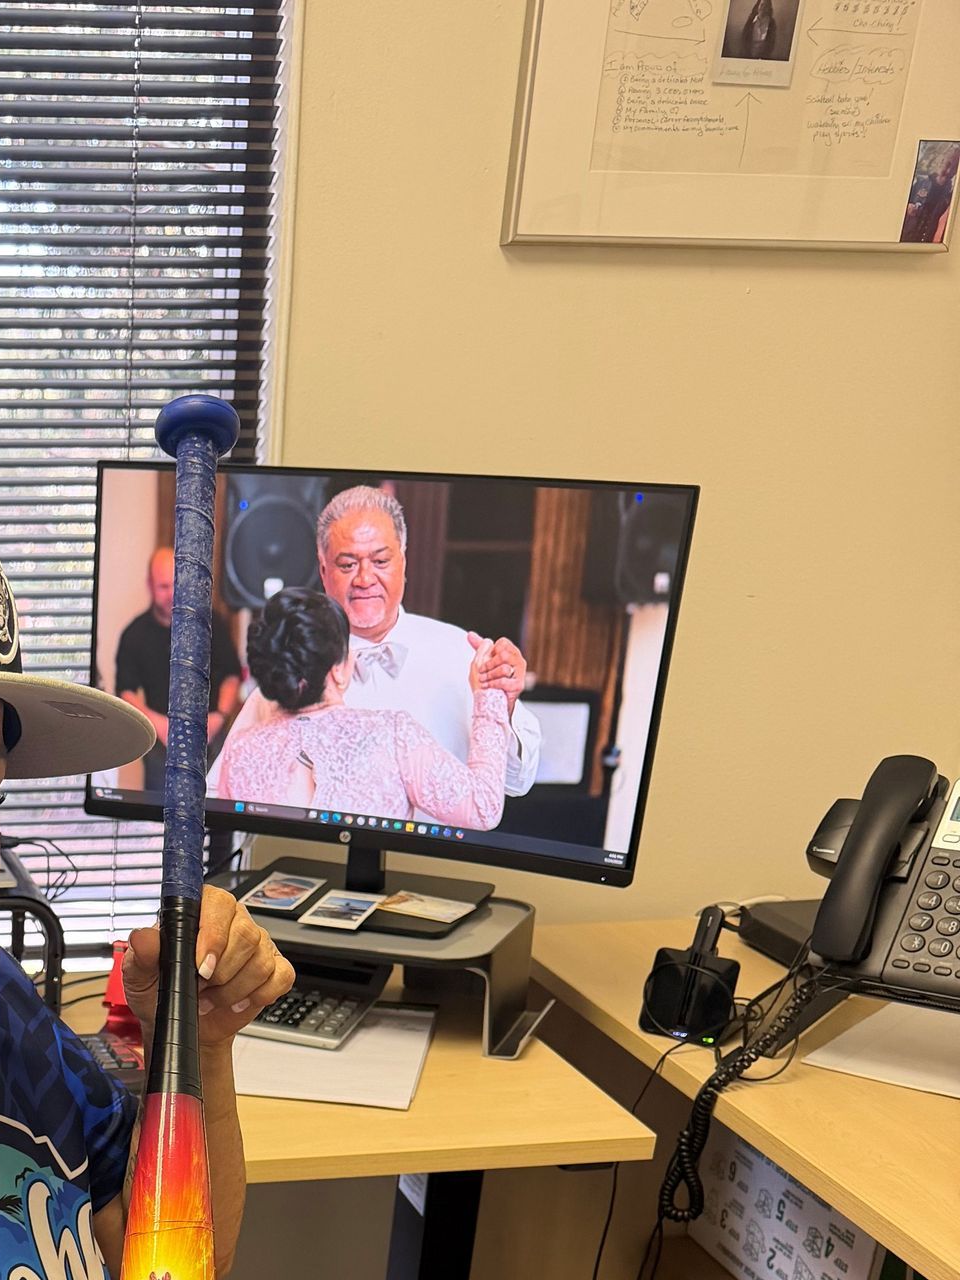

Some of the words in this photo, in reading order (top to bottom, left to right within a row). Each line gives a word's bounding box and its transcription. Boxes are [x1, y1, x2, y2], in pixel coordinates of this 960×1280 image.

[920, 916, 930, 928] 7
[948, 921, 958, 933] 8
[720, 1208, 728, 1228] 3
[775, 1199, 786, 1219] 5
[823, 1236, 835, 1258] 4
[765, 1248, 776, 1270] 2
